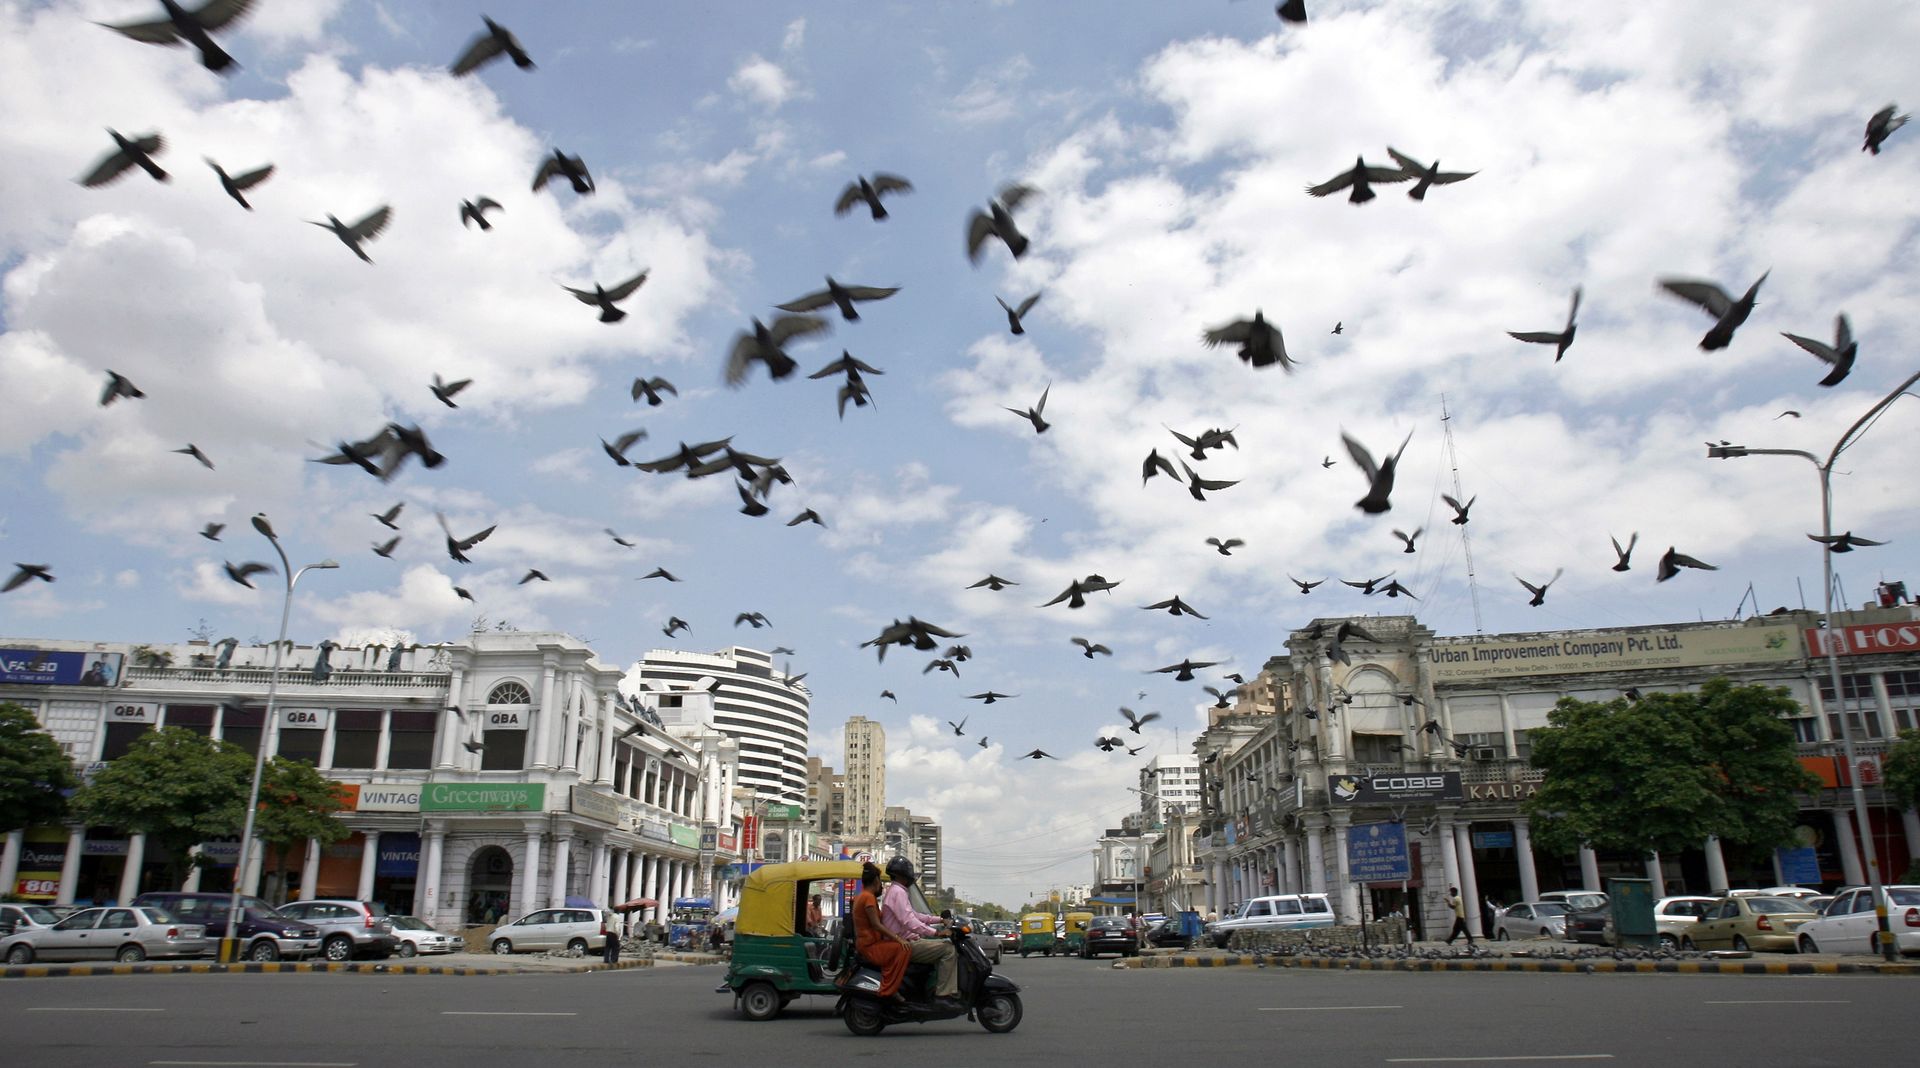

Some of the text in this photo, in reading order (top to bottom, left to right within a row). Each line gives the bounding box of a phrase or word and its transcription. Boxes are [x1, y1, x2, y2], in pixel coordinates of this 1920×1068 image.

[1431, 634, 1683, 664] Urban Improvement Company Pvt. Ltd.
[1456, 667, 1492, 677] Connaught
[1531, 664, 1548, 672] Delhi
[114, 705, 145, 717] QBA
[287, 711, 317, 723] QBA
[491, 713, 518, 724] QBA
[1372, 776, 1444, 790] COBB
[364, 792, 421, 804] VINTAG
[432, 785, 528, 808] Greenways
